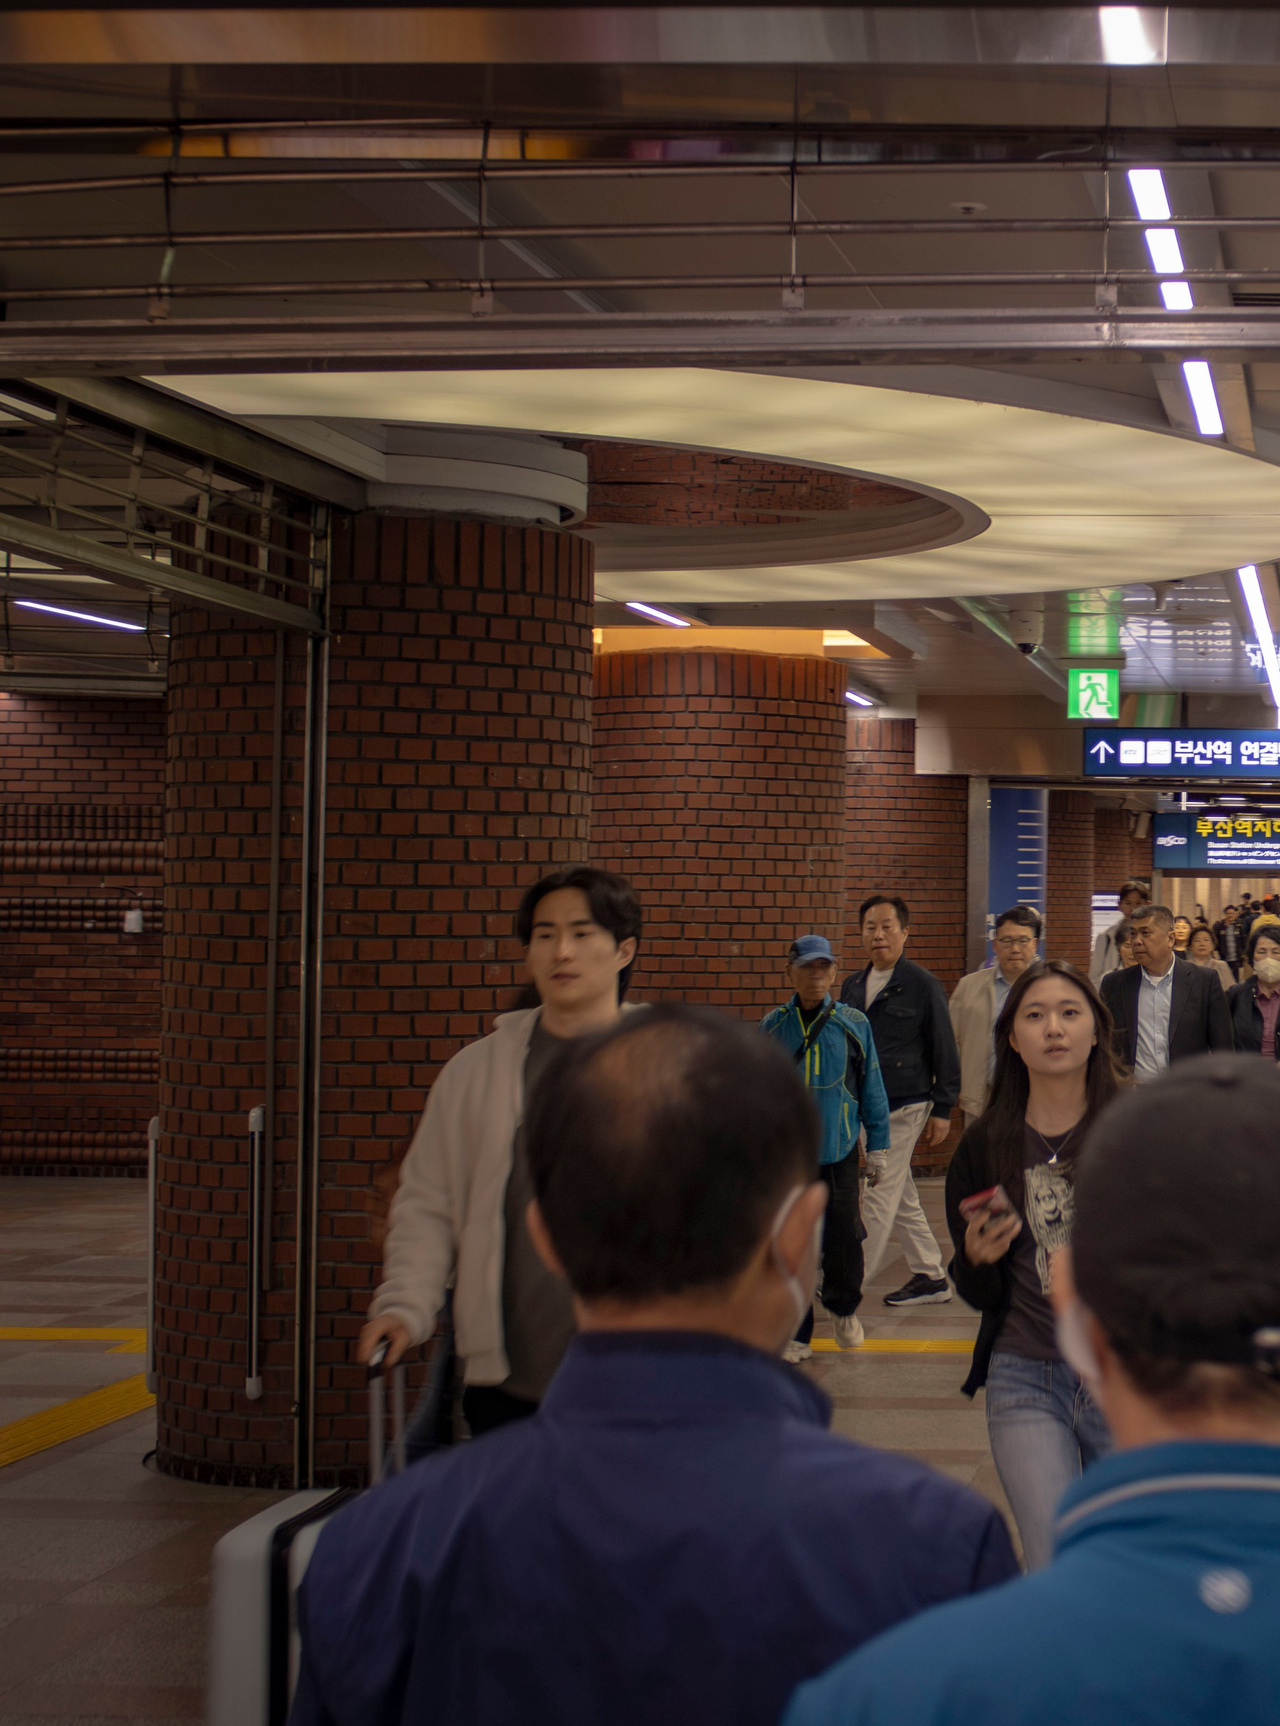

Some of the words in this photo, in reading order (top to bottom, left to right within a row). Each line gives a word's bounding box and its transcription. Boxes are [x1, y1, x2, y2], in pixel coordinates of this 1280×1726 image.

[1174, 740, 1232, 765] 부산역
[1207, 841, 1229, 849] Busan
[1229, 841, 1253, 849] Station
